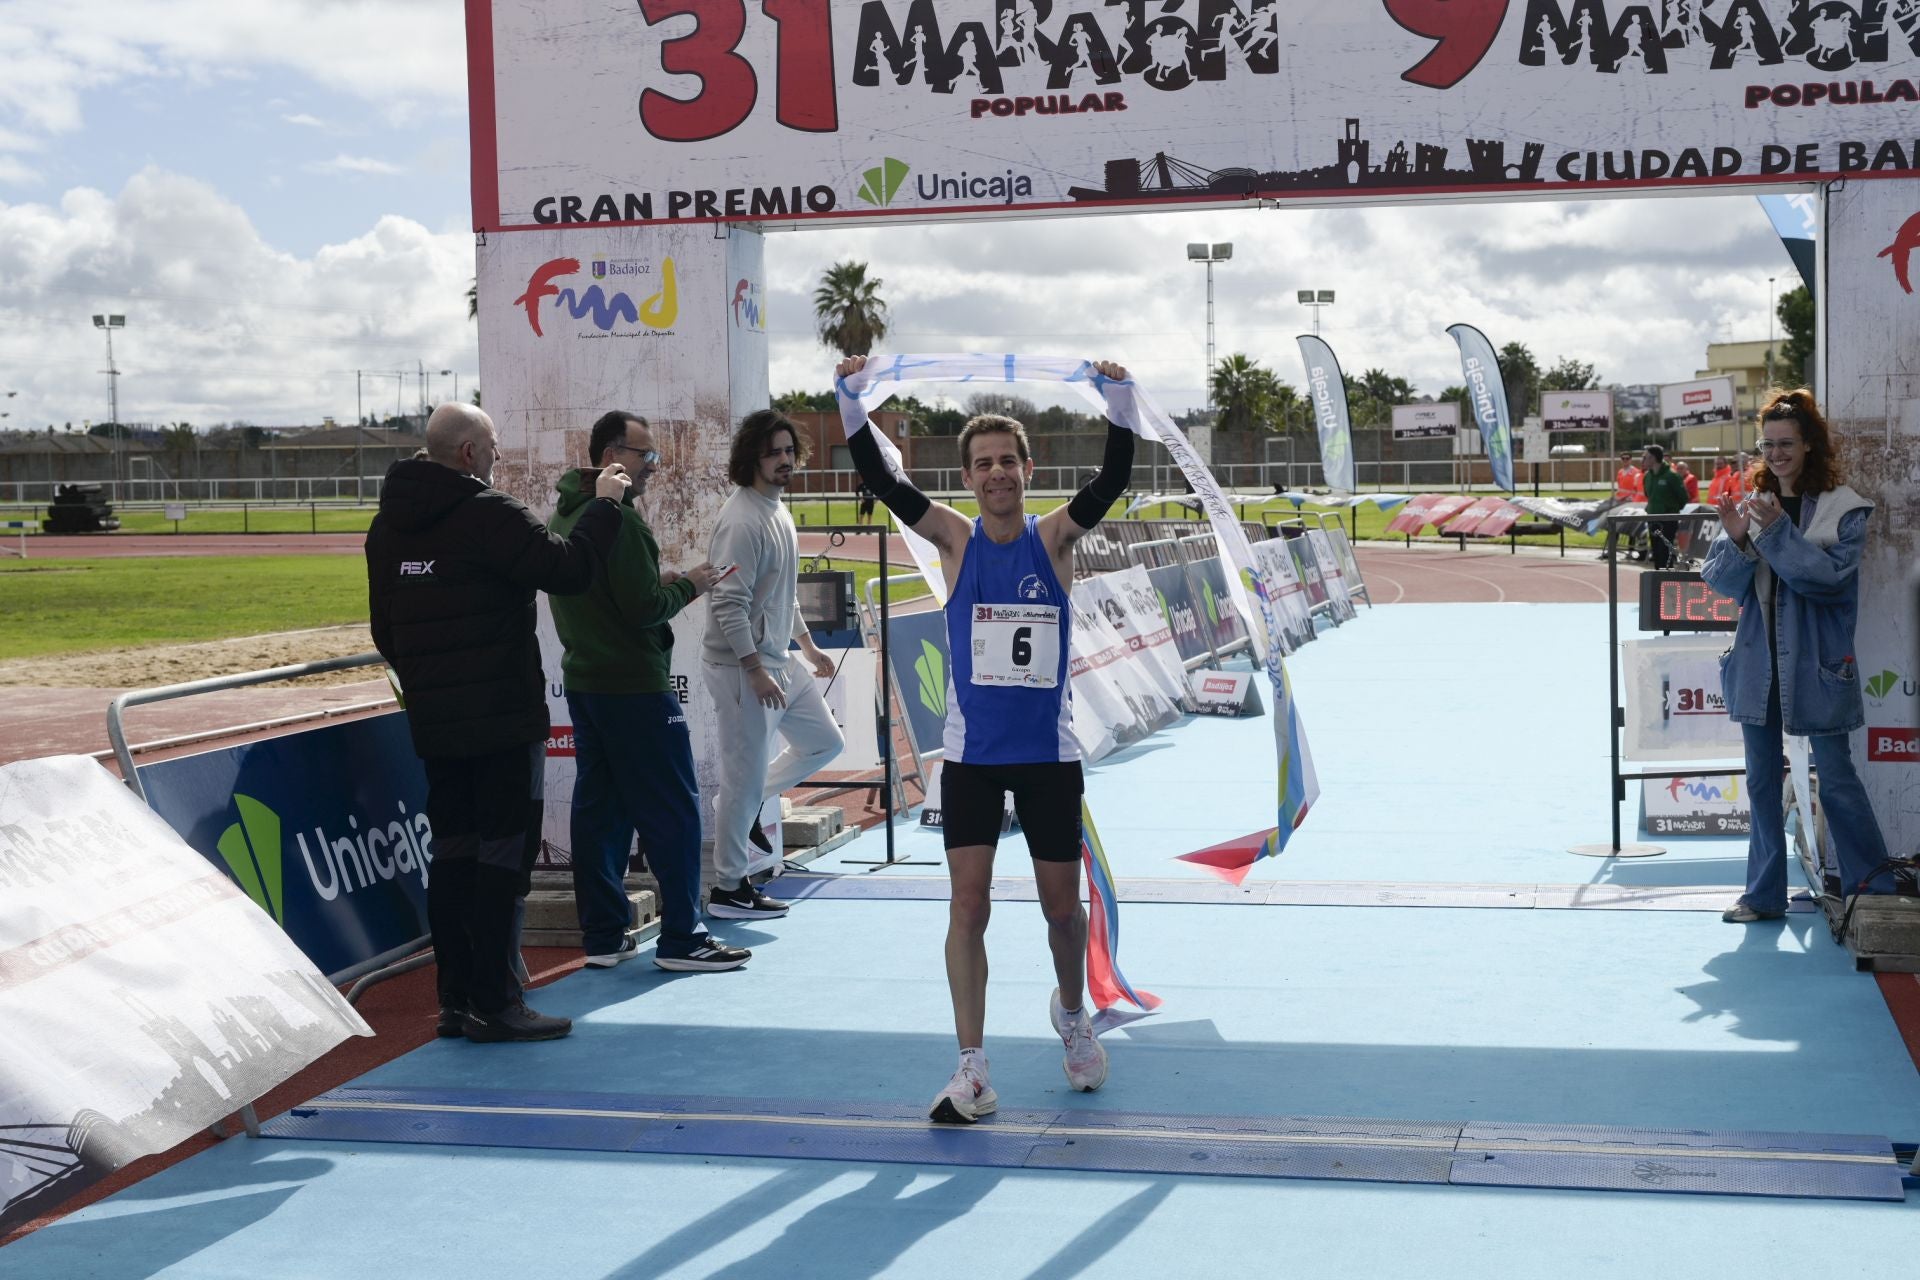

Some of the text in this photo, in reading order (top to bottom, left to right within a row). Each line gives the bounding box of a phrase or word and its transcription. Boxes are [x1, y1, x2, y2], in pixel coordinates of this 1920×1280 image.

[639, 0, 838, 142] 31
[970, 91, 1128, 118] POPULAR
[1744, 79, 1920, 108] POPULA
[1555, 146, 1743, 181] CIUDAD
[1760, 143, 1820, 175] DE
[917, 168, 1033, 204] Unicaja
[533, 184, 837, 225] GRAN PREMIO
[609, 263, 651, 276] Badajoz
[976, 607, 992, 621] 31
[1011, 626, 1032, 666] 6
[1677, 688, 1704, 711] 31
[1656, 819, 1673, 832] 31
[1717, 817, 1727, 830] 9
[296, 800, 433, 901] Unicaja
